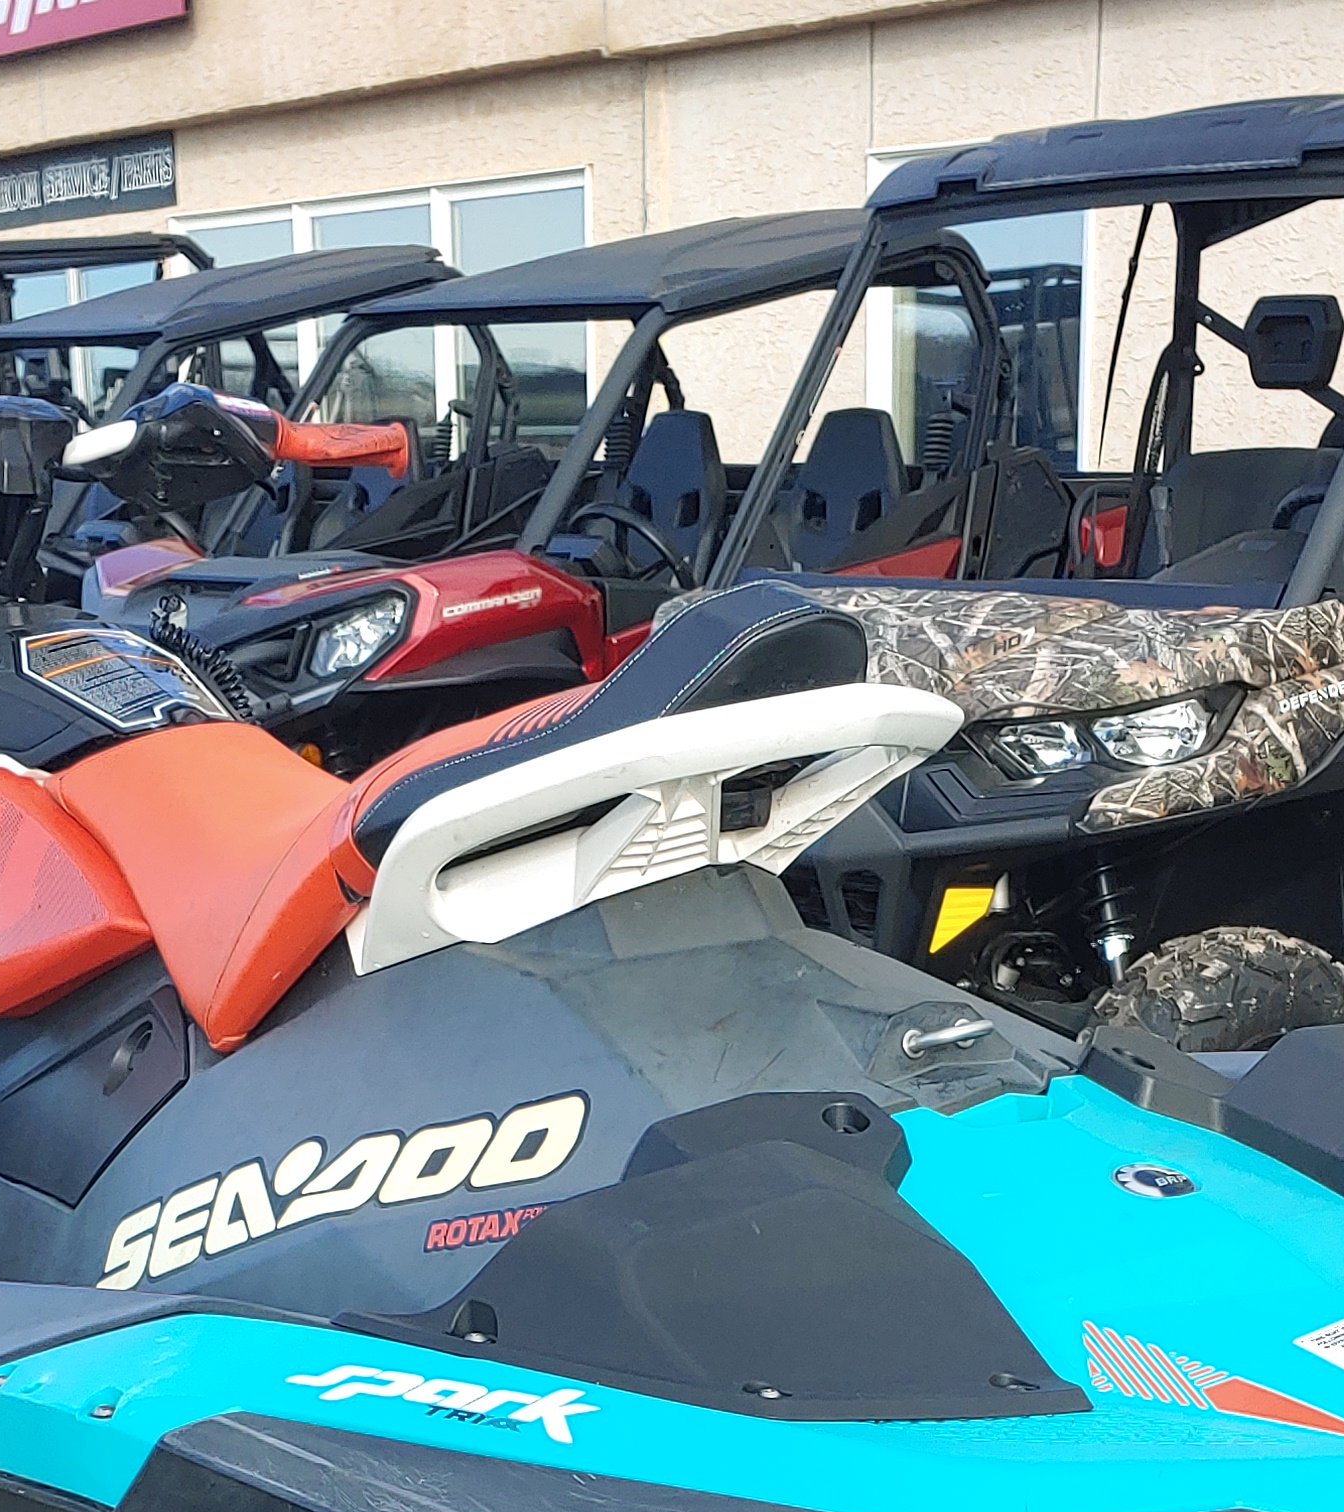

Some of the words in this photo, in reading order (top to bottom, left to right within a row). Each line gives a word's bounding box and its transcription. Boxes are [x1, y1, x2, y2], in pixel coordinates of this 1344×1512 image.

[42, 157, 110, 204] SERVICE
[120, 149, 174, 192] PARTS
[1155, 1175, 1187, 1188] BRP
[425, 1208, 524, 1250] ROTAX
